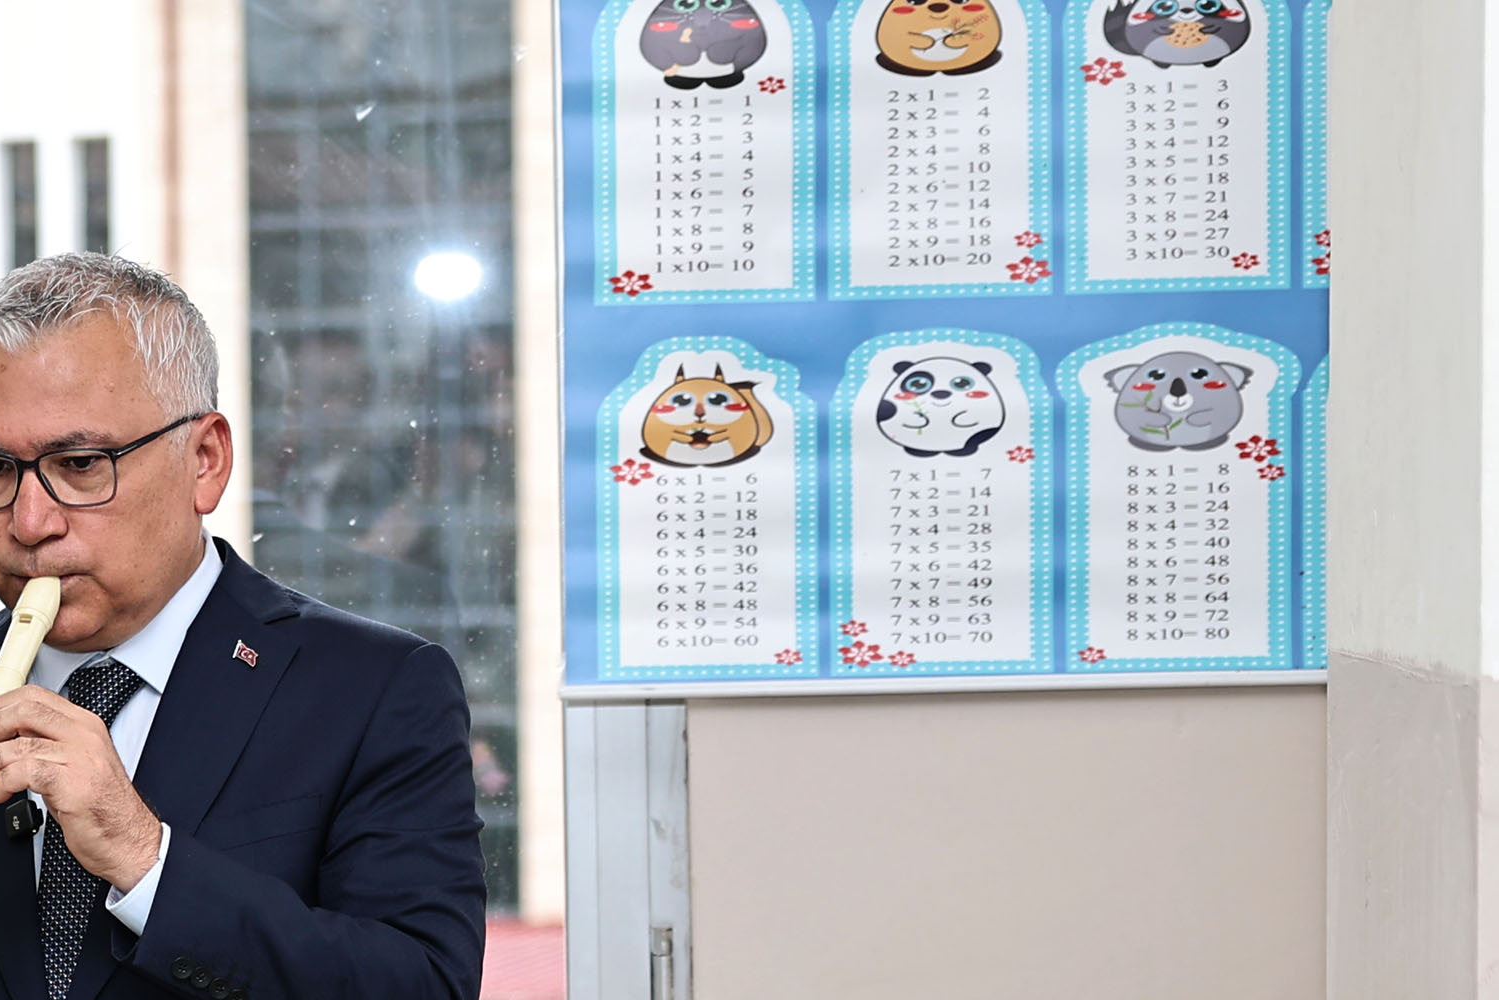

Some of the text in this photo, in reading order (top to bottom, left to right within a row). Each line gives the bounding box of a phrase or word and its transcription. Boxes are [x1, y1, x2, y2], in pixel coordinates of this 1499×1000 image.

[1125, 100, 1138, 114] 3
[1163, 98, 1177, 113] 2
[1216, 97, 1230, 111] 6
[690, 113, 702, 127] 2
[741, 112, 754, 126] 2
[887, 108, 900, 122] 2
[925, 107, 938, 121] 2
[977, 105, 991, 118] 4
[887, 126, 900, 140] 2
[925, 125, 938, 139] 3
[977, 123, 991, 137] 6
[1125, 118, 1138, 133] 3
[1163, 117, 1176, 132] 3
[1216, 116, 1230, 129] 9
[1125, 137, 1138, 151] 3
[1163, 136, 1177, 149] 4
[1207, 134, 1230, 148] 12
[690, 150, 702, 163] 4
[741, 149, 754, 162] 4
[887, 144, 900, 159] 2
[924, 144, 938, 157] 4
[978, 142, 991, 156] 8
[690, 169, 703, 183] 5
[742, 167, 754, 181] 5
[887, 163, 900, 177] 2
[925, 162, 938, 177] 5
[968, 160, 992, 174] 10
[887, 181, 901, 195] 2
[925, 180, 939, 194] 6
[968, 178, 991, 193] 12
[1126, 174, 1138, 188] 3
[1164, 173, 1177, 186] 6
[1207, 171, 1230, 185] 18
[689, 187, 703, 200] 6
[741, 186, 755, 198] 6
[689, 204, 703, 218] 7
[742, 203, 754, 217] 7
[1126, 210, 1138, 225] 3
[1164, 210, 1177, 223] 8
[1204, 208, 1230, 222] 24
[690, 223, 703, 237] 8
[742, 222, 754, 235] 8
[1126, 229, 1138, 243] 3
[1163, 228, 1177, 242] 9
[1204, 226, 1230, 241] 27
[888, 236, 901, 250] 2
[926, 235, 939, 248] 9
[969, 234, 992, 248] 18
[655, 492, 669, 505] 6
[693, 490, 706, 504] 2
[736, 489, 757, 504] 12
[889, 487, 902, 501] 7
[927, 486, 940, 500] 2
[970, 485, 992, 499] 14
[889, 505, 902, 519] 7
[927, 504, 940, 519] 3
[967, 503, 989, 518] 21
[1127, 501, 1139, 515] 8
[1165, 500, 1177, 514] 3
[1204, 499, 1230, 513] 24
[656, 510, 669, 522] 6
[693, 509, 706, 523] 3
[736, 508, 758, 522] 18
[889, 523, 903, 537] 7
[927, 523, 940, 536] 4
[967, 522, 993, 536] 28
[1126, 519, 1139, 533] 8
[1164, 519, 1177, 531] 4
[1205, 517, 1230, 532] 32
[656, 528, 669, 541] 6
[693, 527, 706, 539] 4
[733, 526, 758, 539] 24
[656, 546, 669, 558] 6
[694, 545, 706, 558] 5
[733, 543, 759, 557] 30
[1126, 537, 1139, 551] 8
[1165, 536, 1177, 551] 5
[1204, 536, 1231, 549] 40
[656, 564, 669, 576] 6
[694, 563, 707, 576] 6
[733, 562, 759, 576] 36
[1126, 556, 1139, 569] 8
[1164, 556, 1178, 568] 6
[1204, 554, 1230, 567] 48
[890, 577, 903, 591] 7
[927, 577, 941, 590] 7
[967, 577, 993, 589] 49
[1126, 574, 1139, 587] 8
[1164, 573, 1178, 587] 7
[1205, 572, 1231, 586] 56
[656, 582, 670, 595] 6
[694, 580, 707, 594] 7
[732, 580, 757, 593] 42
[656, 600, 670, 612] 6
[694, 599, 707, 612] 8
[732, 598, 758, 611] 48
[890, 595, 903, 609] 7
[928, 595, 940, 608] 8
[968, 594, 993, 608] 56
[1126, 592, 1139, 605] 8
[1164, 591, 1177, 605] 8
[1204, 591, 1229, 603] 64
[889, 613, 903, 627] 7
[927, 613, 941, 626] 9
[967, 612, 992, 626] 63
